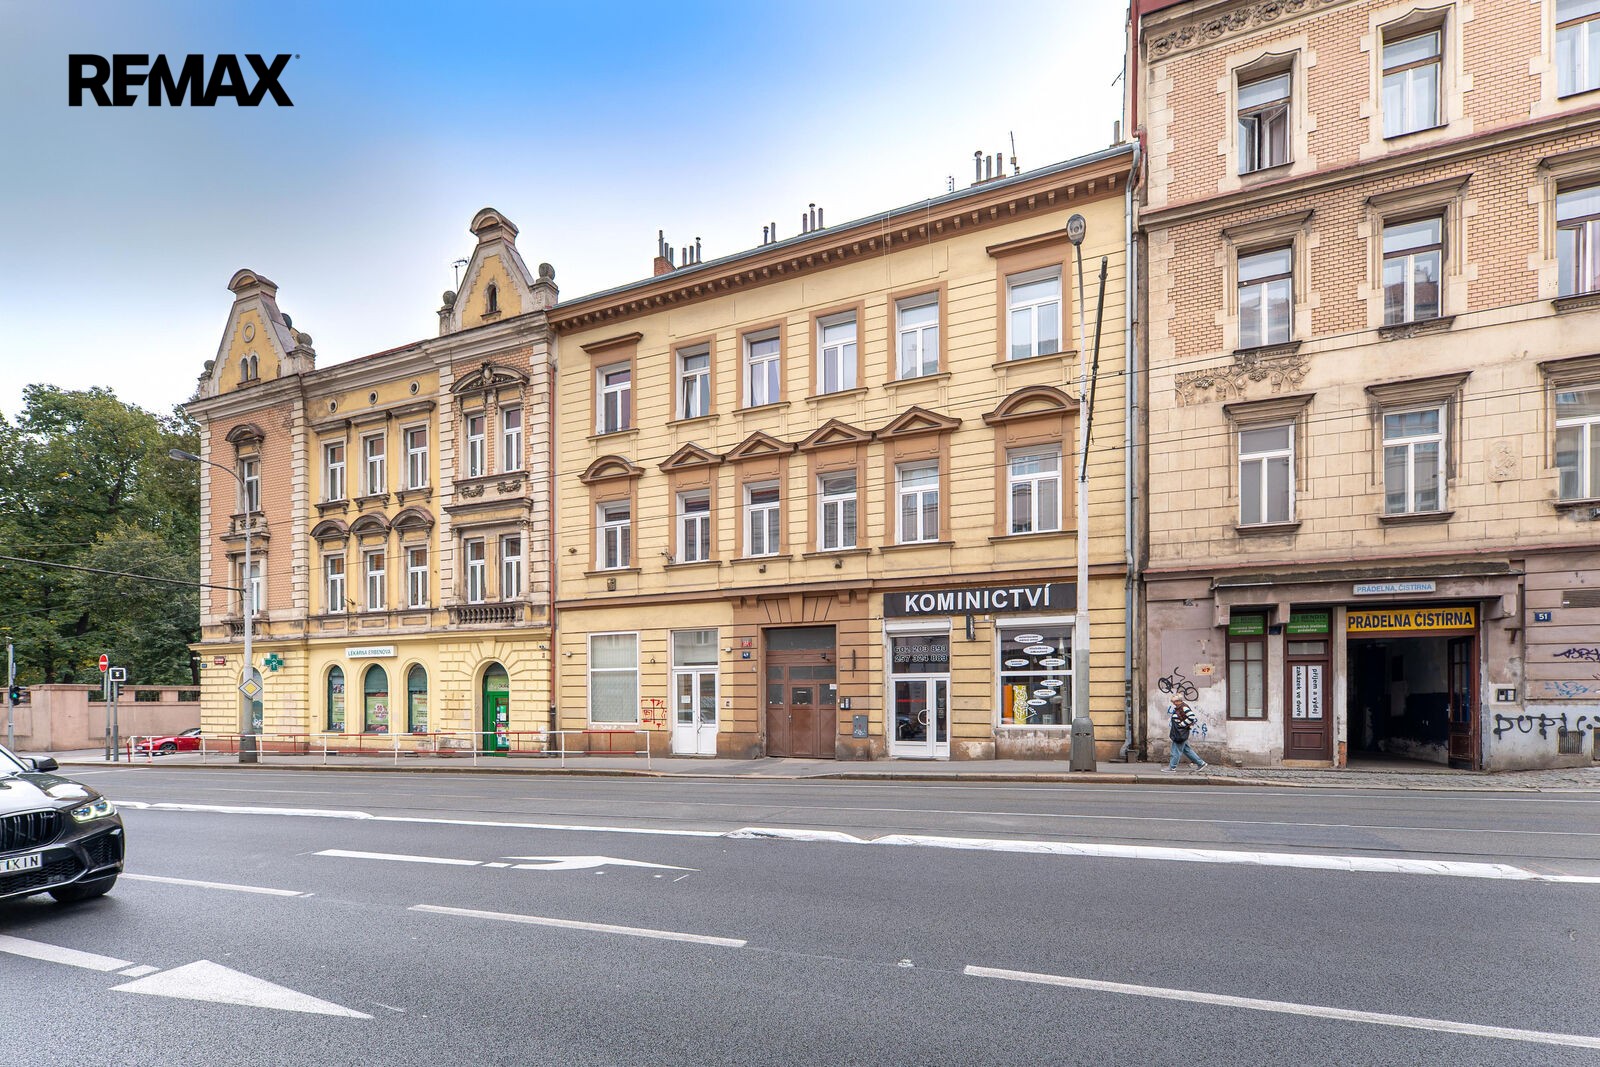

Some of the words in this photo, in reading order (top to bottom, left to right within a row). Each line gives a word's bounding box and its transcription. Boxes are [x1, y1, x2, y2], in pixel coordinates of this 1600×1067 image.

[1398, 583, 1432, 592] ČISTÍRNA
[905, 584, 1051, 612] KOMINICTVÍ
[1348, 612, 1411, 628] PRÁDELNA
[1414, 611, 1472, 626] ČISTÍRNA
